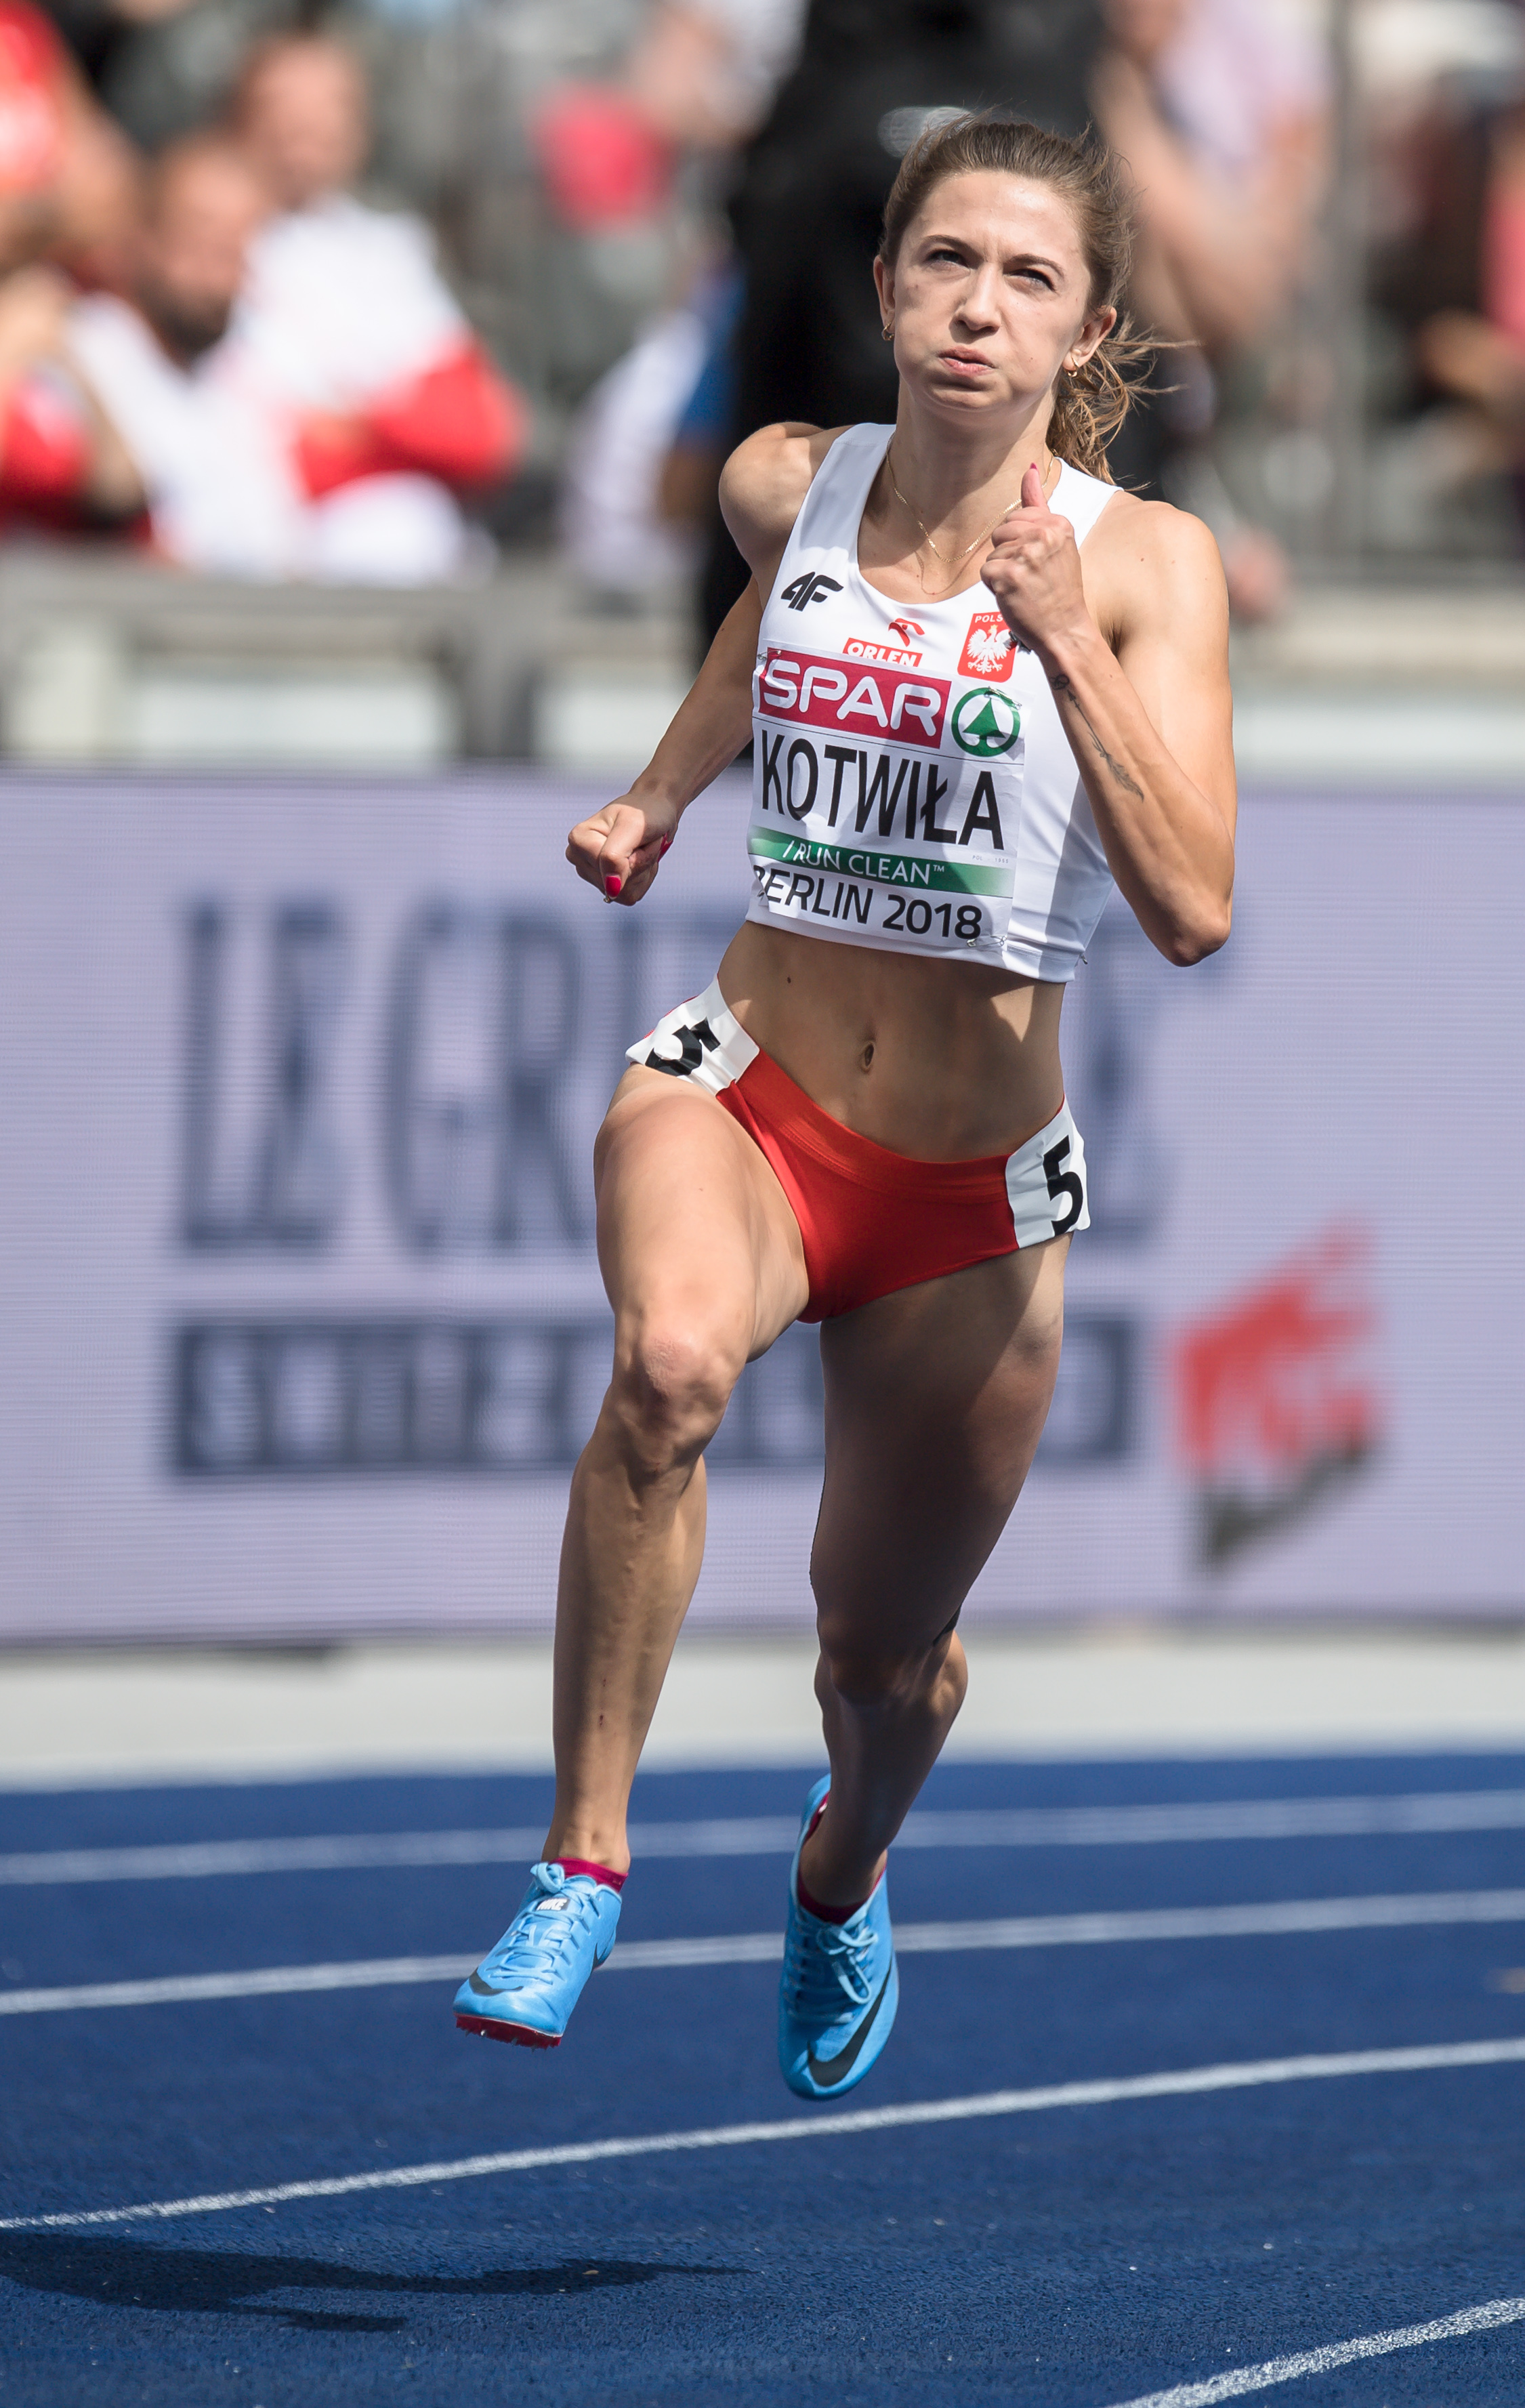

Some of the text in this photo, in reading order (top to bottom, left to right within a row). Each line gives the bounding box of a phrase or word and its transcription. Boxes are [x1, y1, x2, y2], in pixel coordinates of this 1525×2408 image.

[780, 571, 845, 612] 4F
[974, 614, 1003, 623] POLS
[847, 642, 918, 667] ORLEN
[763, 659, 942, 736] SPAR
[761, 729, 1005, 850] KOTWIŁA
[793, 842, 841, 871] RUN
[882, 894, 982, 940] 2018
[645, 1016, 722, 1078] 5
[1042, 1134, 1083, 1237] 5
